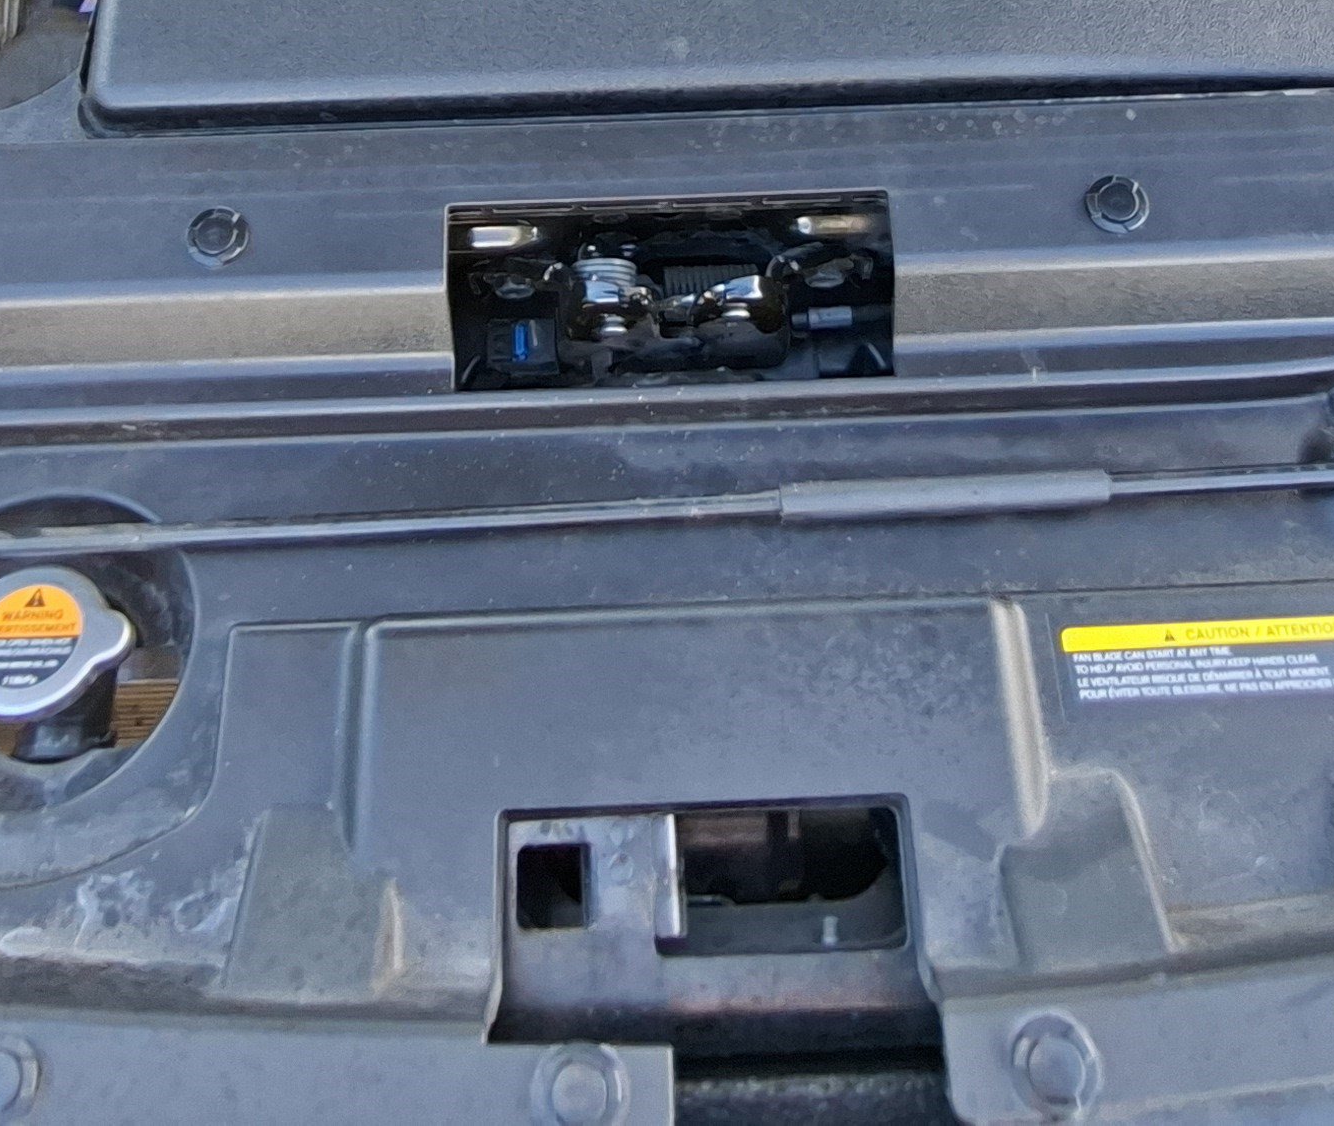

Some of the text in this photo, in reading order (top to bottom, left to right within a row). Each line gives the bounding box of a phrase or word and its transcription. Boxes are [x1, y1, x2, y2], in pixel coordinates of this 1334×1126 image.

[3, 609, 64, 621] WARNING
[1186, 626, 1250, 641] CAUTION
[1072, 652, 1092, 663] FAN
[1092, 651, 1124, 662] BLADE
[1124, 650, 1145, 661] CAN
[1146, 648, 1175, 660] START
[1176, 648, 1186, 657] AT
[1189, 647, 1207, 657] ANY
[1075, 664, 1089, 674] TO
[1089, 663, 1114, 674] HELP
[1115, 662, 1144, 673] AVOID
[1145, 660, 1195, 671] PERSONAL
[1252, 656, 1286, 666] HANDS
[1077, 677, 1089, 688] LE
[1187, 672, 1201, 683] DE
[1079, 688, 1107, 700] POUR
